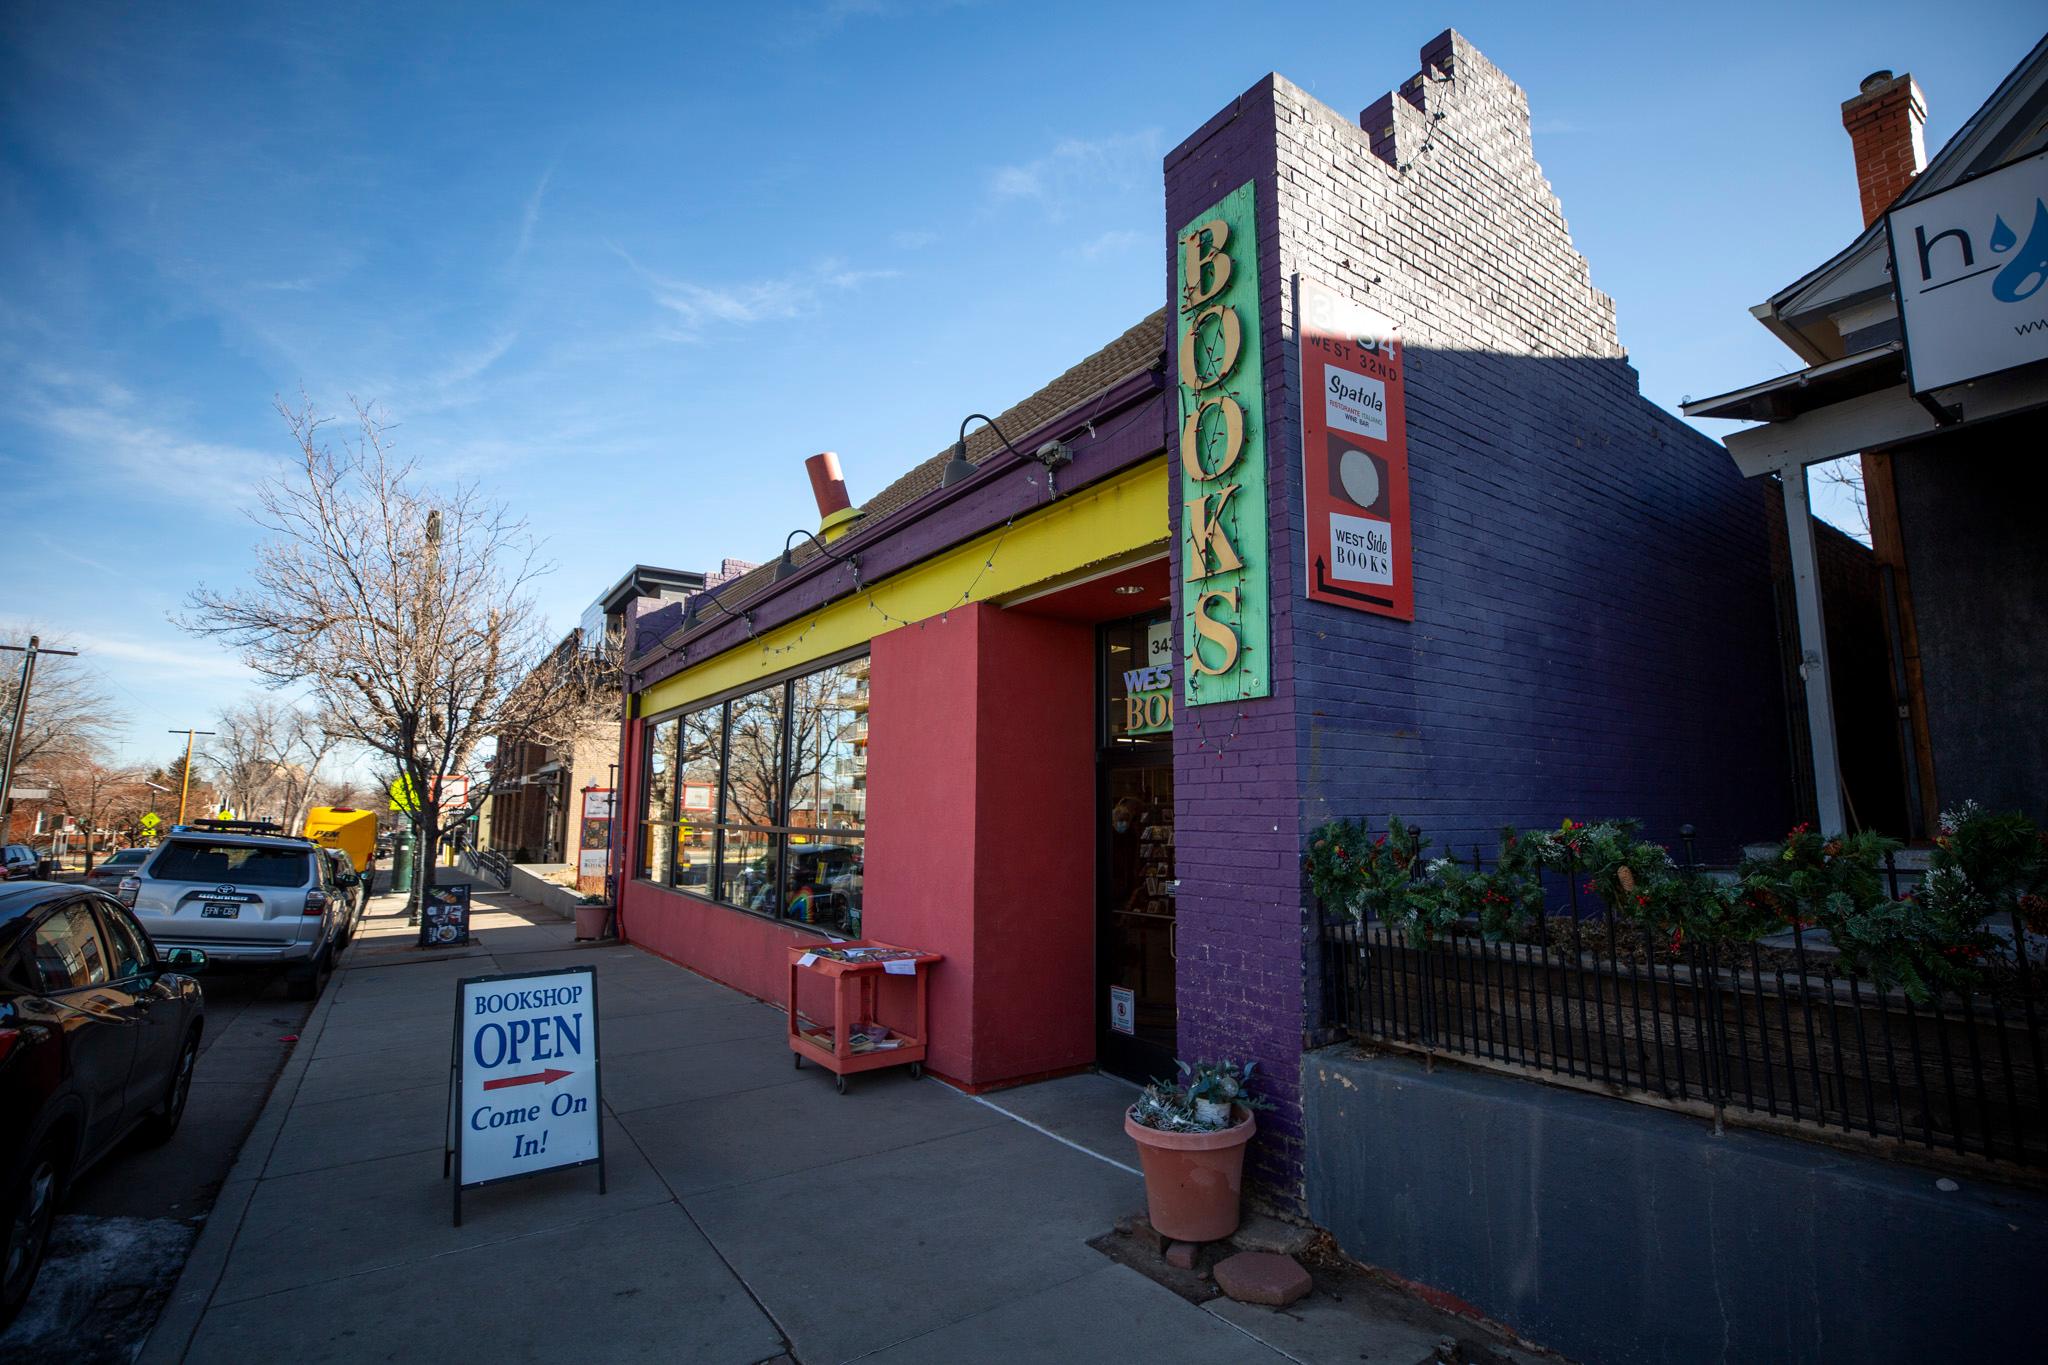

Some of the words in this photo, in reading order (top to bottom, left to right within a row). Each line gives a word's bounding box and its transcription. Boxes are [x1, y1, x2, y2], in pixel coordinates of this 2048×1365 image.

[1311, 334, 1351, 361] WEST
[1359, 355, 1397, 381] 32ND
[1328, 375, 1383, 412] Spatola
[1181, 219, 1243, 676] BOOKS
[1335, 528, 1365, 548] WEST
[1366, 530, 1388, 555] Side
[1336, 545, 1388, 576] BOOKS
[474, 985, 582, 1015] BOOKSHOP
[473, 1012, 582, 1069] OPEN
[471, 1104, 540, 1131] Come
[551, 1092, 588, 1117] On
[512, 1129, 549, 1159] In!
